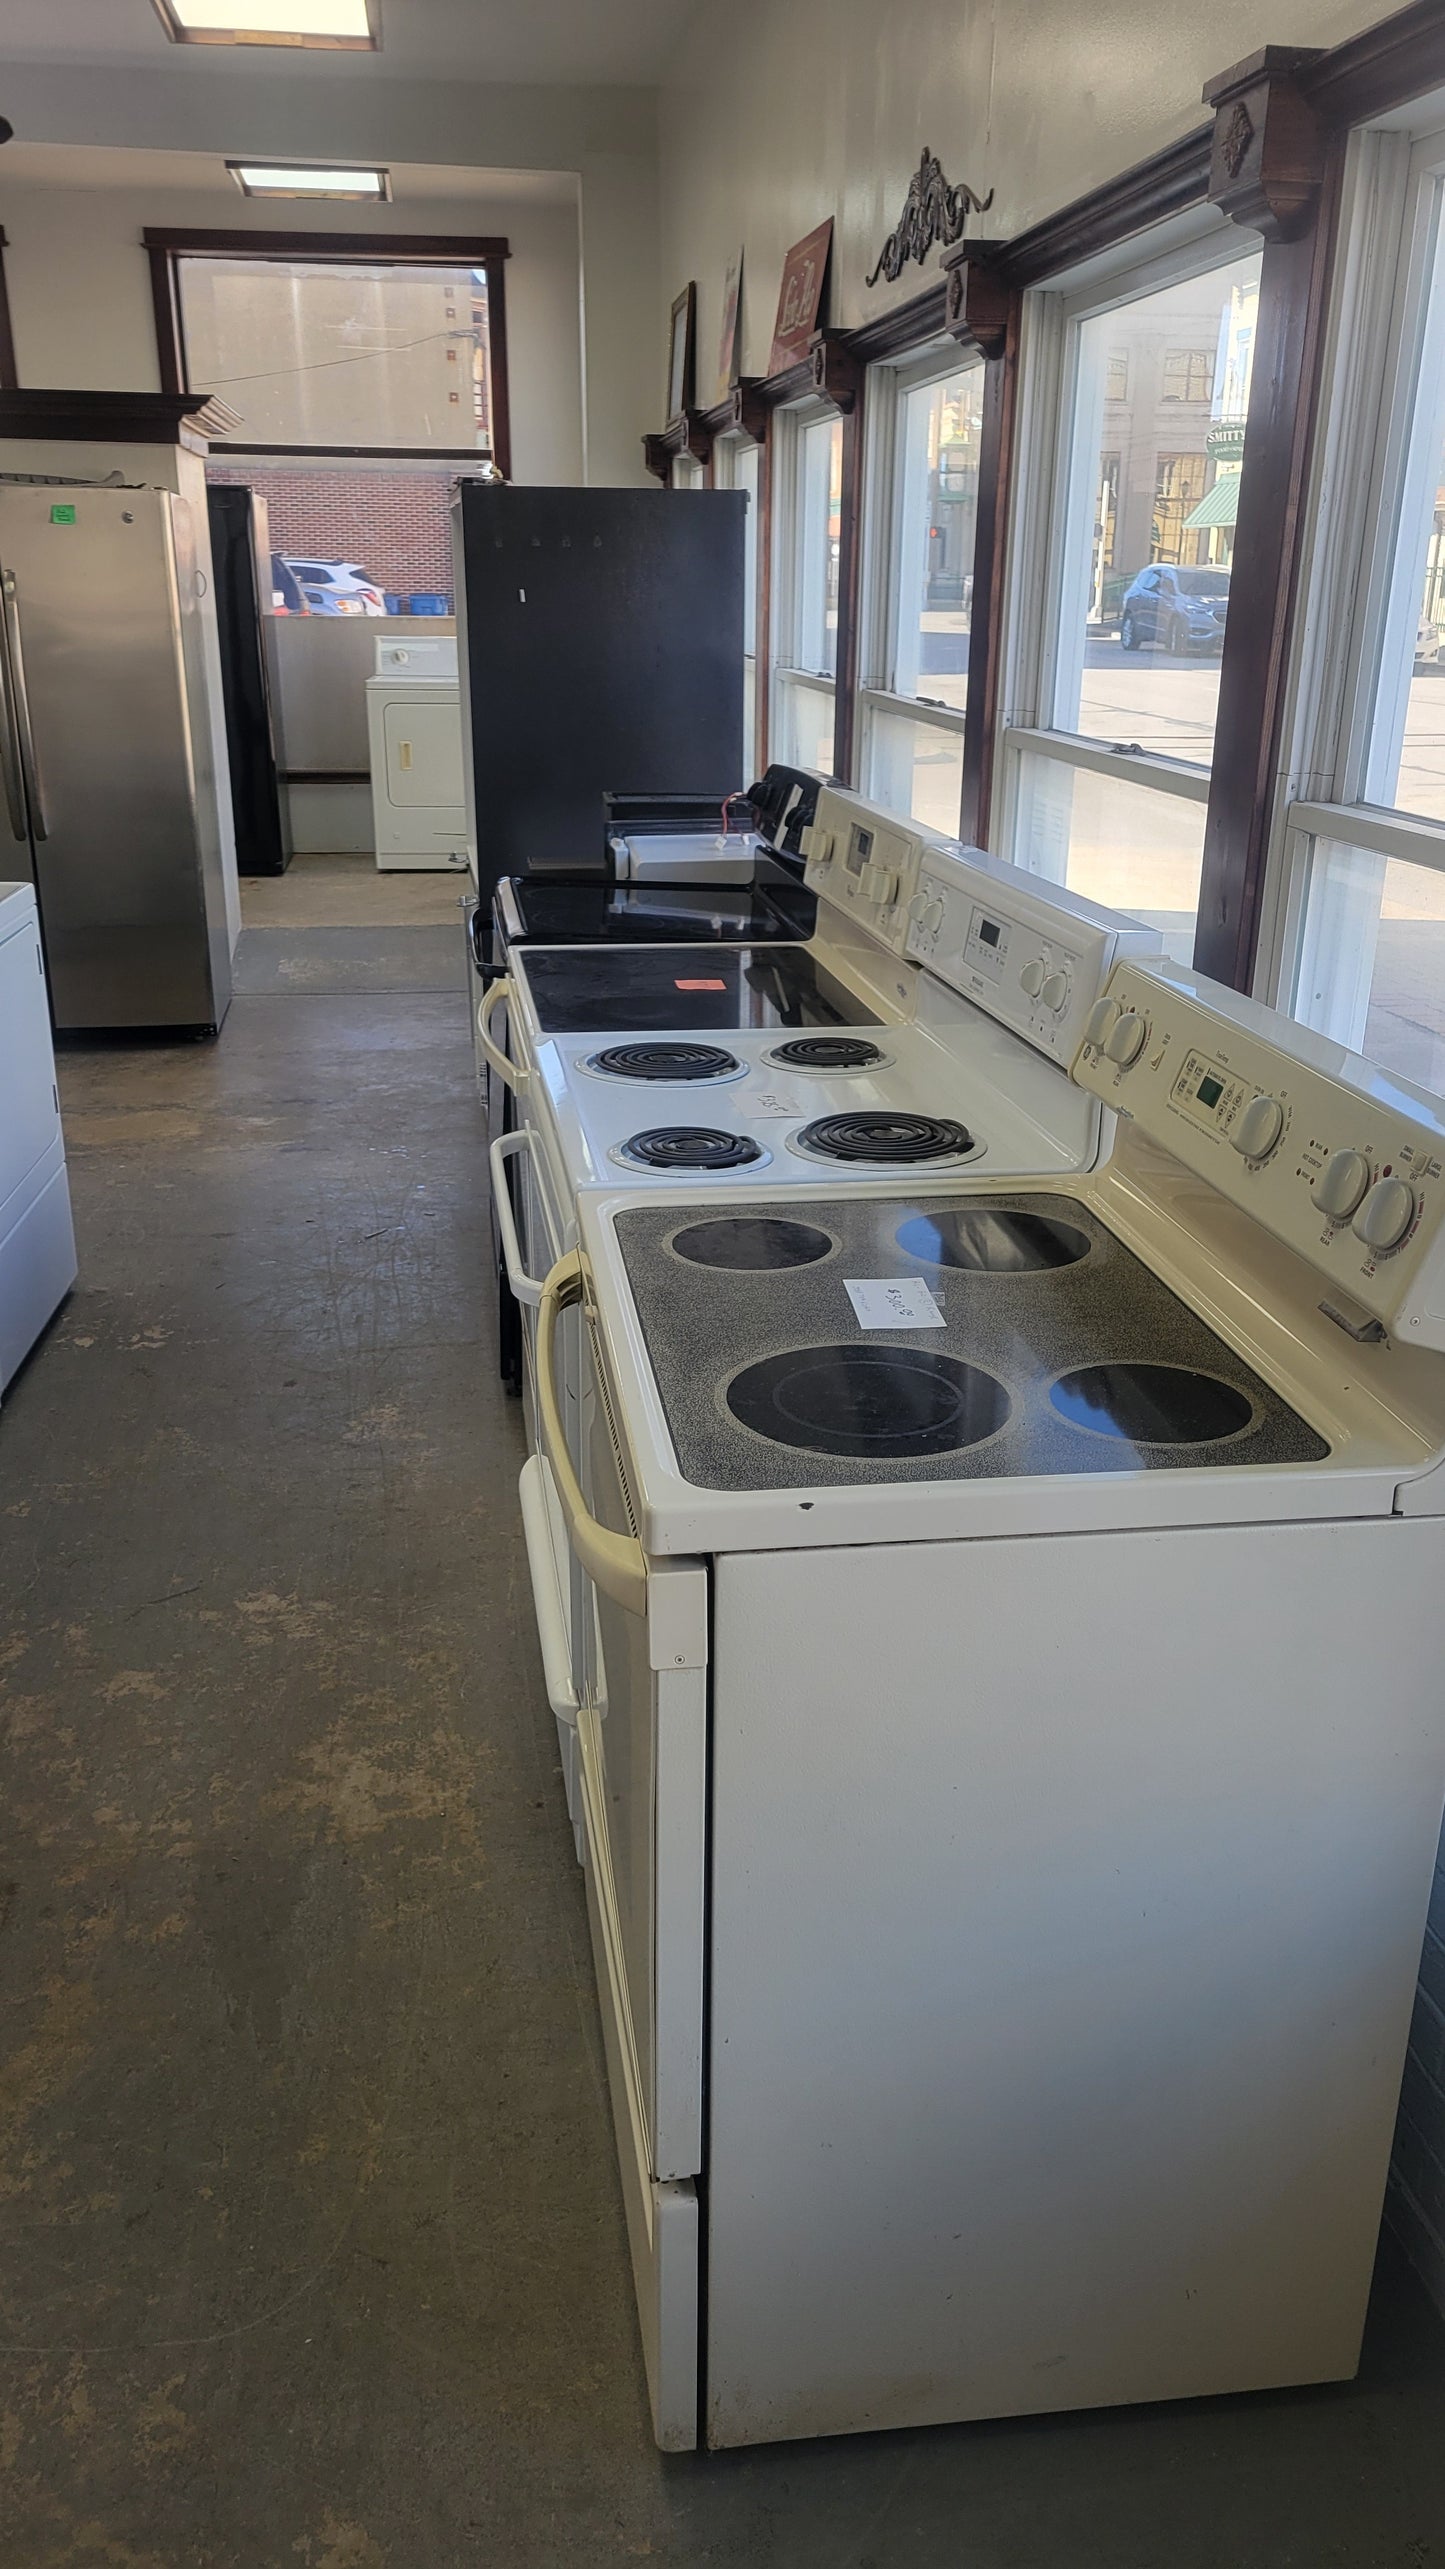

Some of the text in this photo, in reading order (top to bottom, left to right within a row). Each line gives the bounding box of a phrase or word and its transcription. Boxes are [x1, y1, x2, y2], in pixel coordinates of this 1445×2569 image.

[1365, 1144, 1374, 1154] OFF
[1320, 1237, 1331, 1247] REAR
[1360, 1267, 1374, 1278] FRONT
